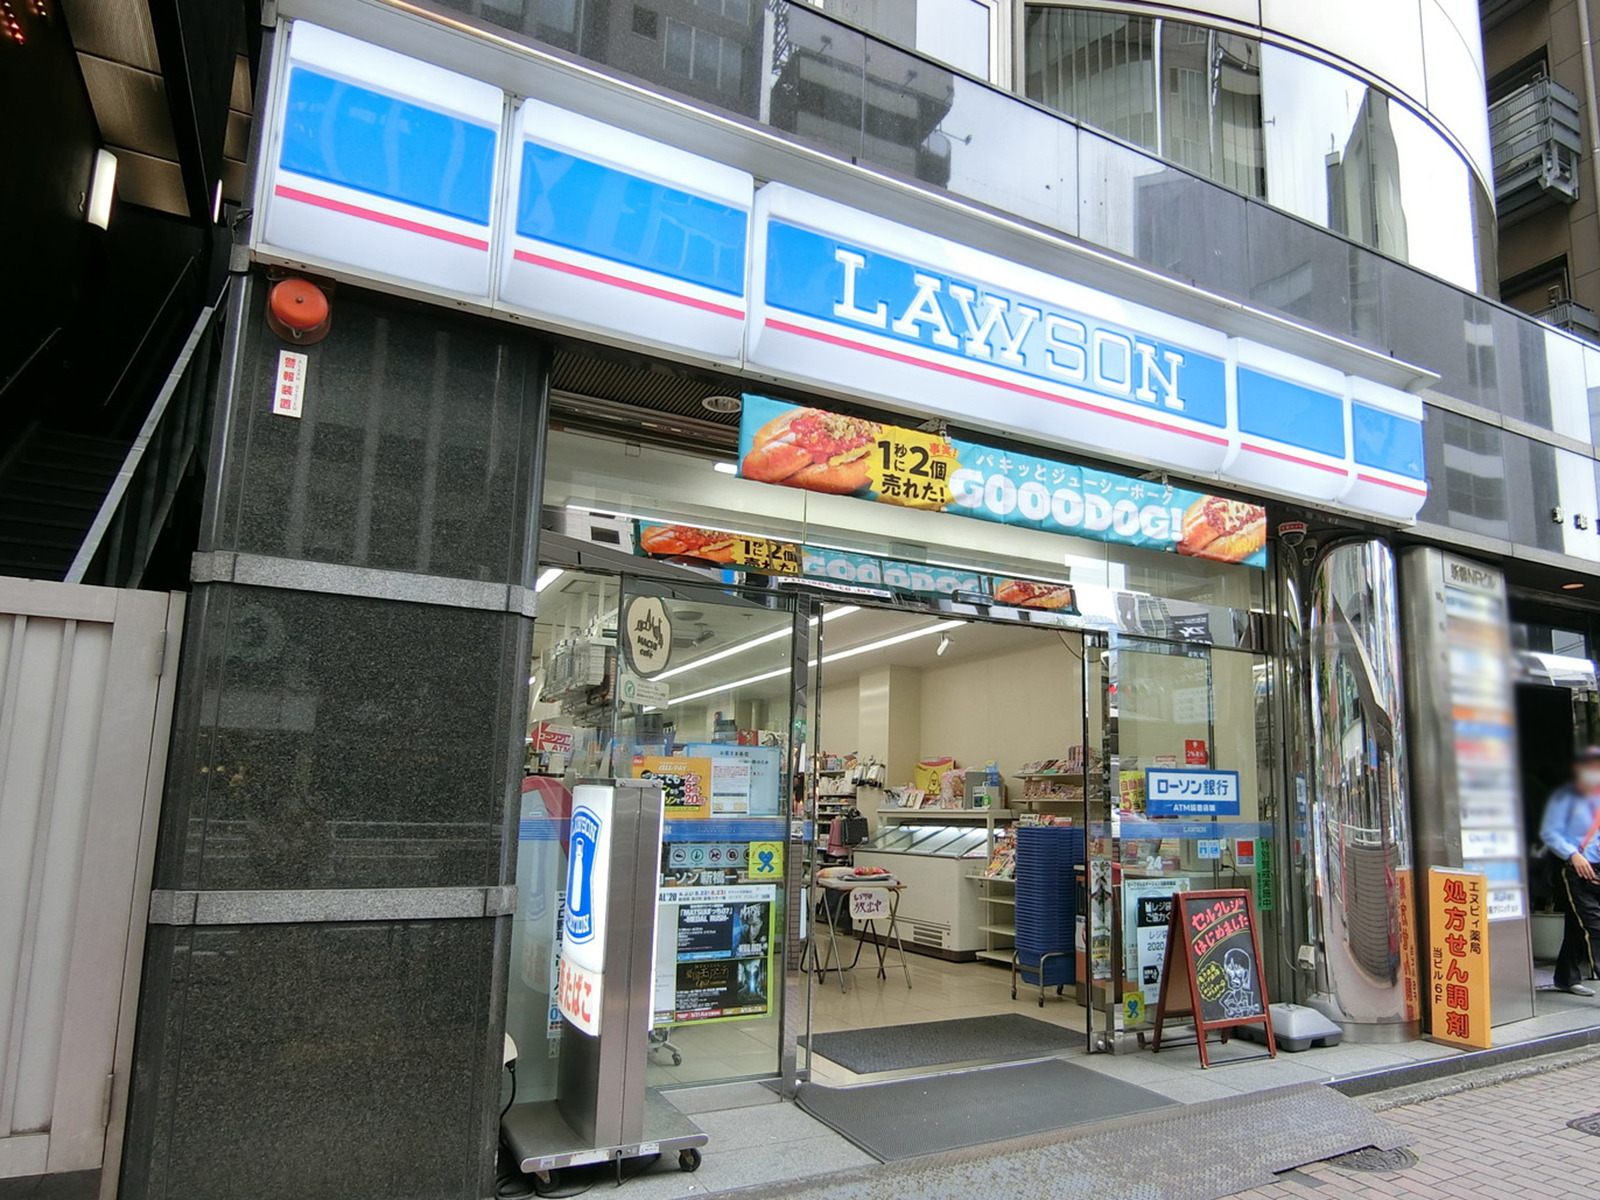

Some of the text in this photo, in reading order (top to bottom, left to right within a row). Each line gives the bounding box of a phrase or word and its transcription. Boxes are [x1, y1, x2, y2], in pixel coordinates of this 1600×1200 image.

[833, 248, 1187, 413] LAWSON
[948, 467, 1184, 542] GOOODOG!
[976, 454, 1174, 505] パキッとジューシーポーク
[1157, 779, 1229, 796] ローソン銀行
[1146, 856, 1163, 871] 24
[1194, 913, 1249, 956] はじめました
[1469, 881, 1482, 955] エヌビィ薬局
[1443, 878, 1470, 1040] 処方せん調剤
